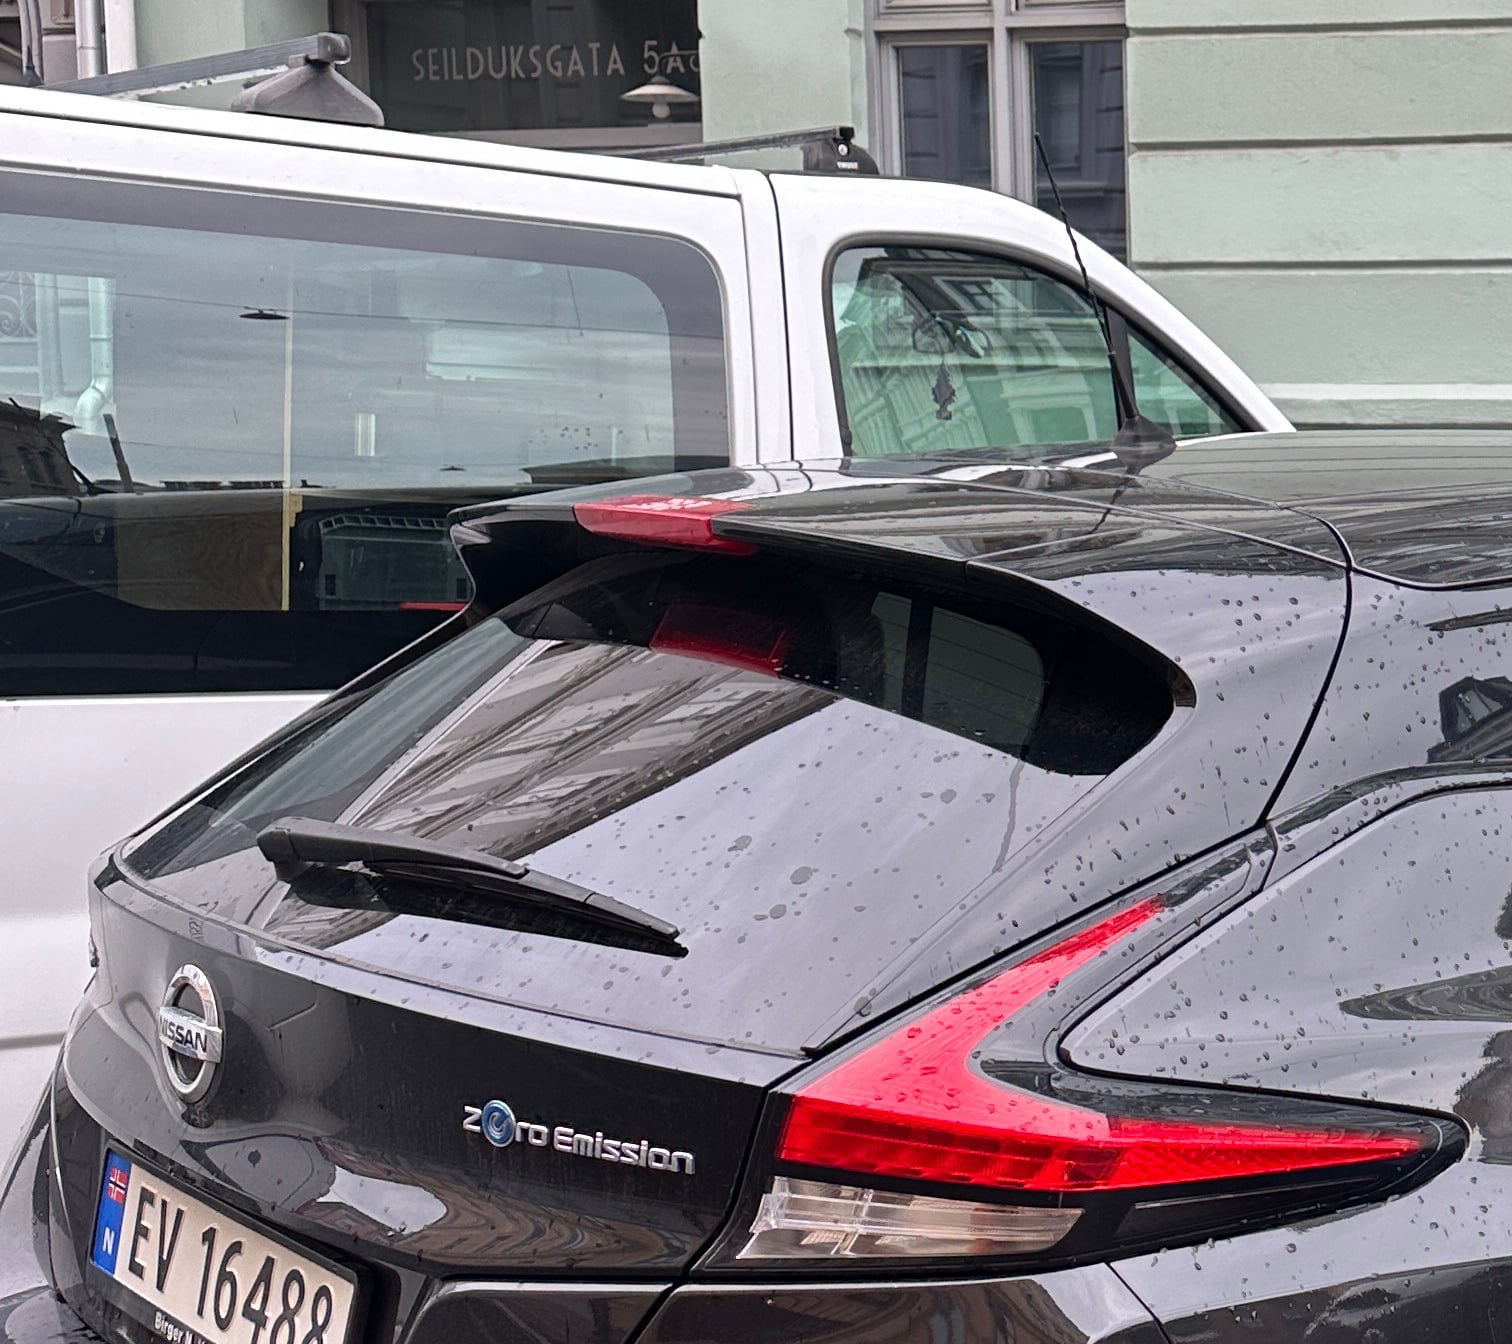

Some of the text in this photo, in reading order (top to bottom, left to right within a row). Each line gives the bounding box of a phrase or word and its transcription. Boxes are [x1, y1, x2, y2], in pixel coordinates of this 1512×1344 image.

[411, 43, 626, 82] SEILDUKSGATA
[159, 1016, 208, 1054] NISSAN
[552, 1125, 696, 1176] Emission
[101, 1225, 115, 1256] N
[127, 1184, 185, 1294] EV
[154, 1311, 184, 1344] Birger
